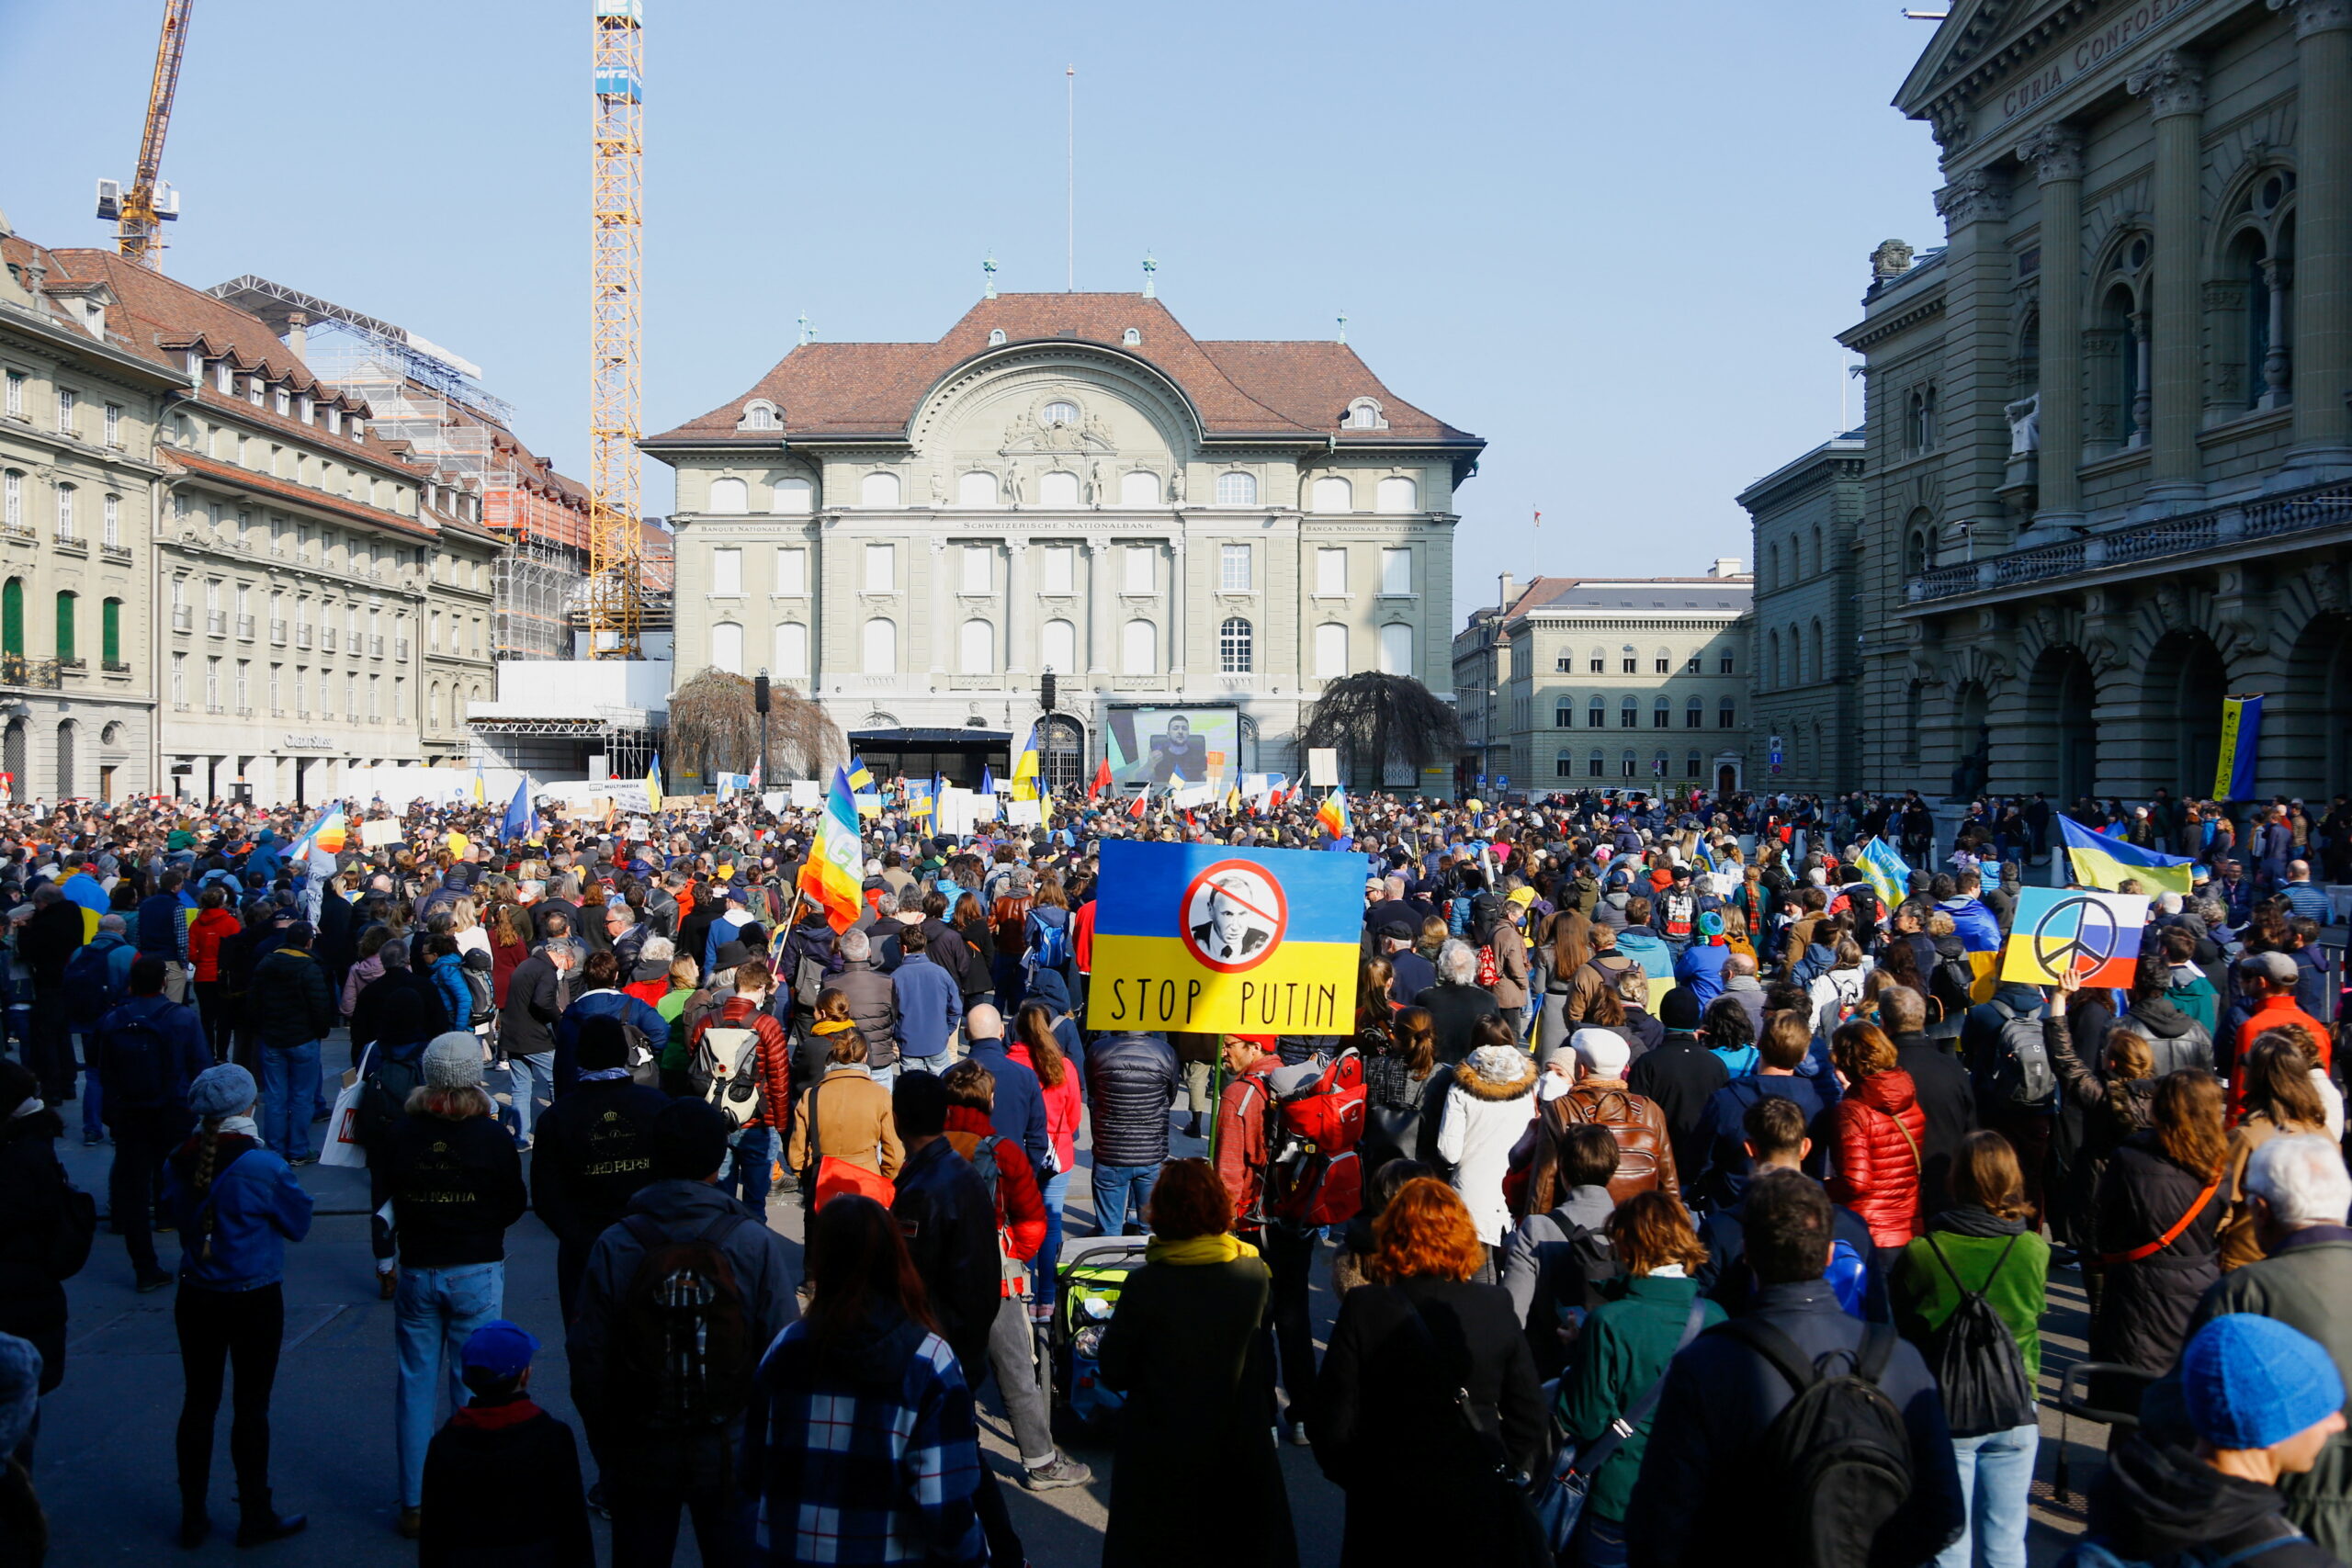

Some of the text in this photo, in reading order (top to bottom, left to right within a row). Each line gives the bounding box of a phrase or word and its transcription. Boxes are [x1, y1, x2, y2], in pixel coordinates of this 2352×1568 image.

[2004, 65, 2063, 118] CURIA
[1111, 977, 1336, 1028] STOP PUTIN
[614, 1157, 651, 1173] PEPSI
